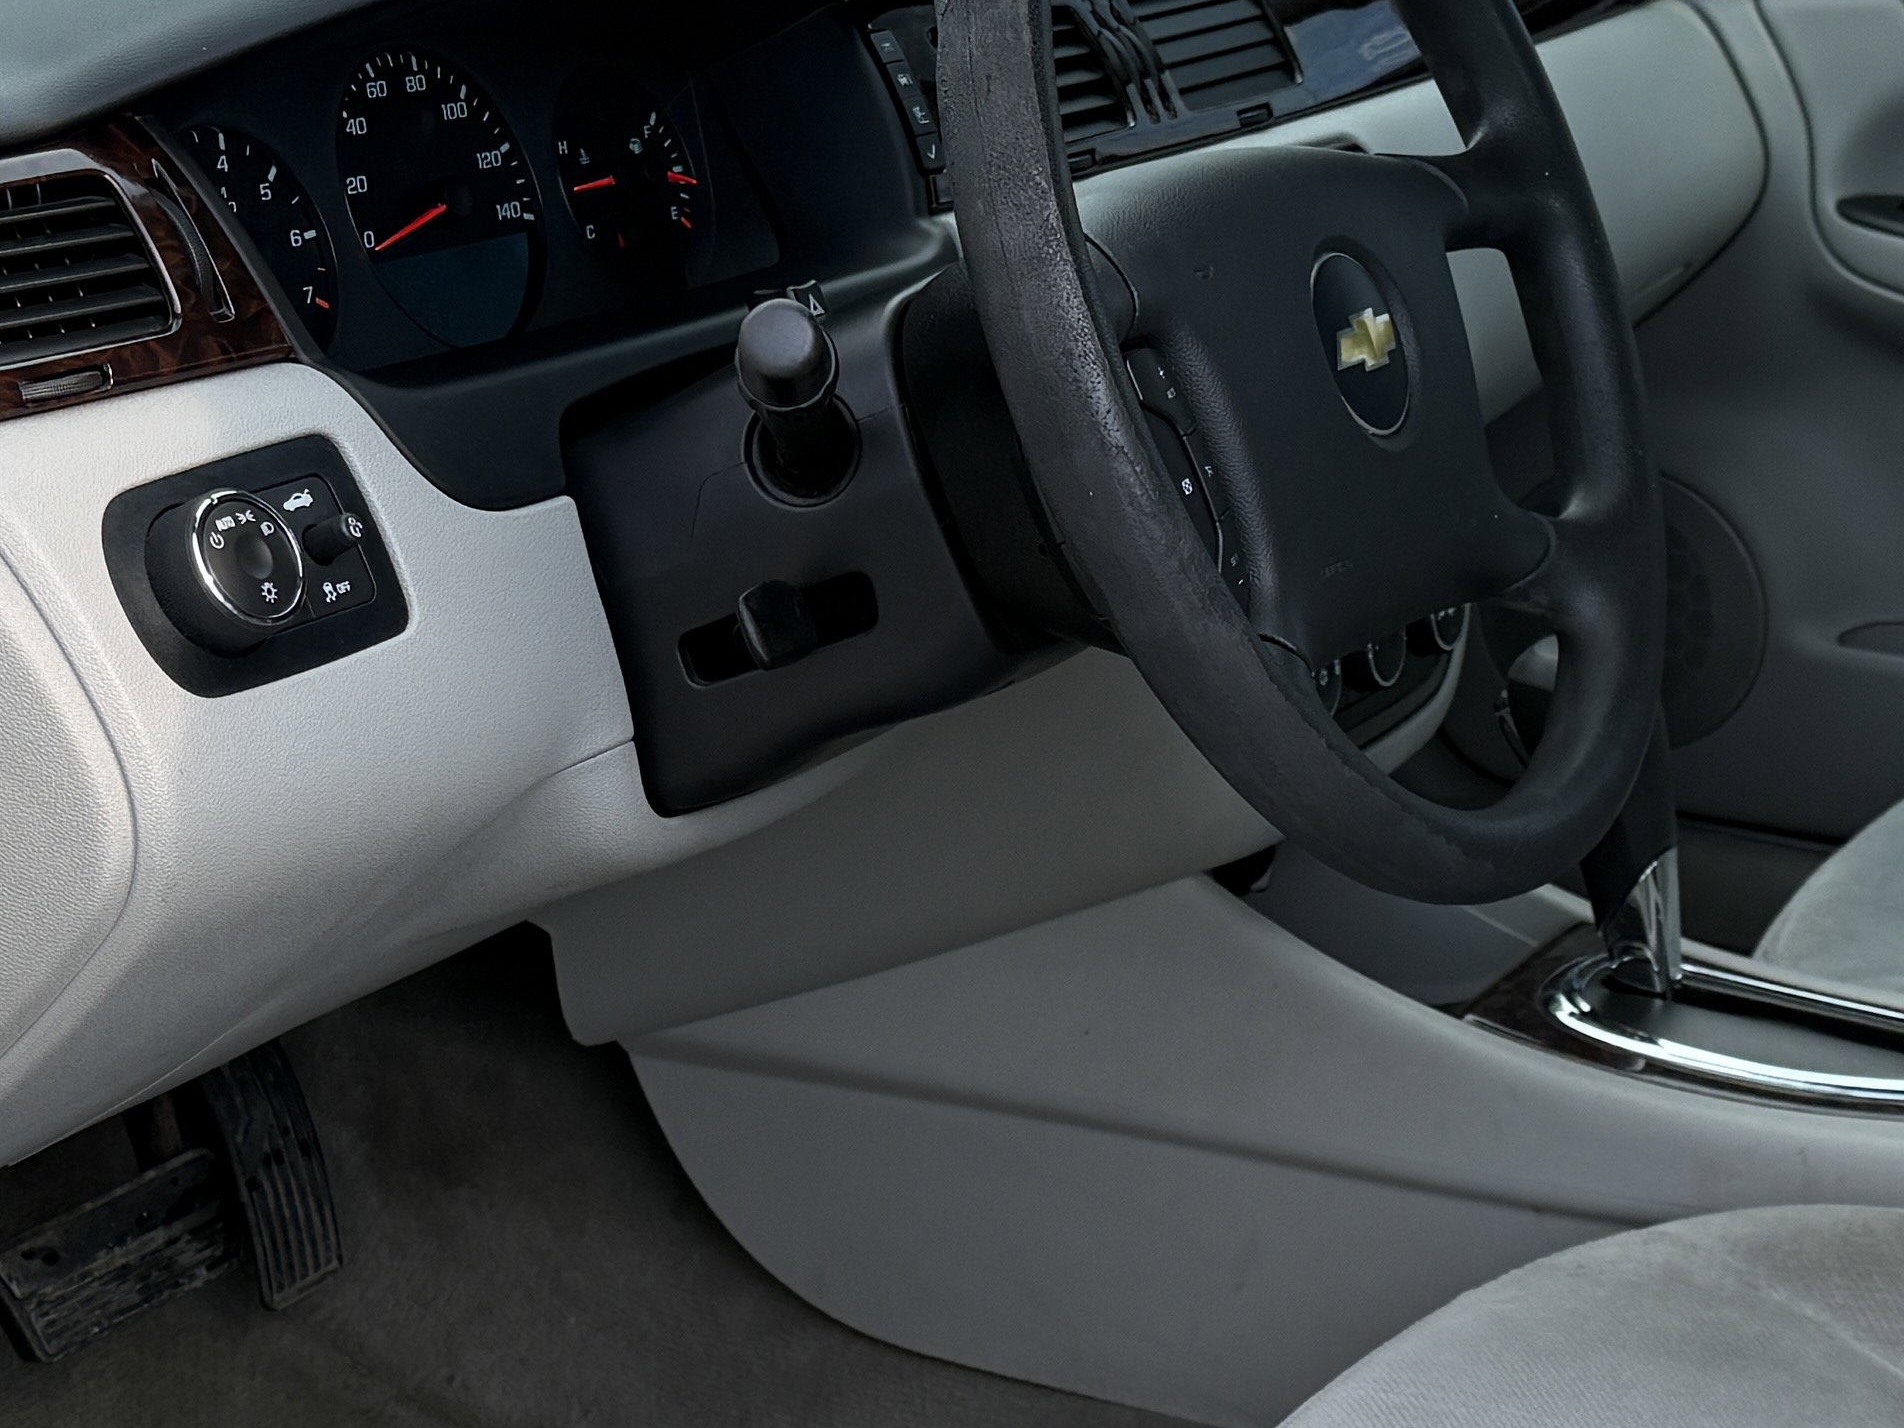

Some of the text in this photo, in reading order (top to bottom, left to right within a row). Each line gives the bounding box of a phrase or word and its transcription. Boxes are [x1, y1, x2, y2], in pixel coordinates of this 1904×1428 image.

[366, 80, 387, 98] 60
[405, 75, 426, 92] 80
[441, 102, 468, 120] 100
[346, 117, 367, 135] 40
[558, 140, 568, 155] H
[216, 155, 228, 172] 4
[476, 150, 502, 169] 120
[259, 183, 272, 200] 5
[346, 175, 368, 194] 20
[496, 201, 521, 220] 140
[670, 206, 679, 220] E
[290, 229, 302, 247] 6
[363, 230, 375, 248] 0
[586, 225, 596, 239] C
[303, 286, 313, 304] 7
